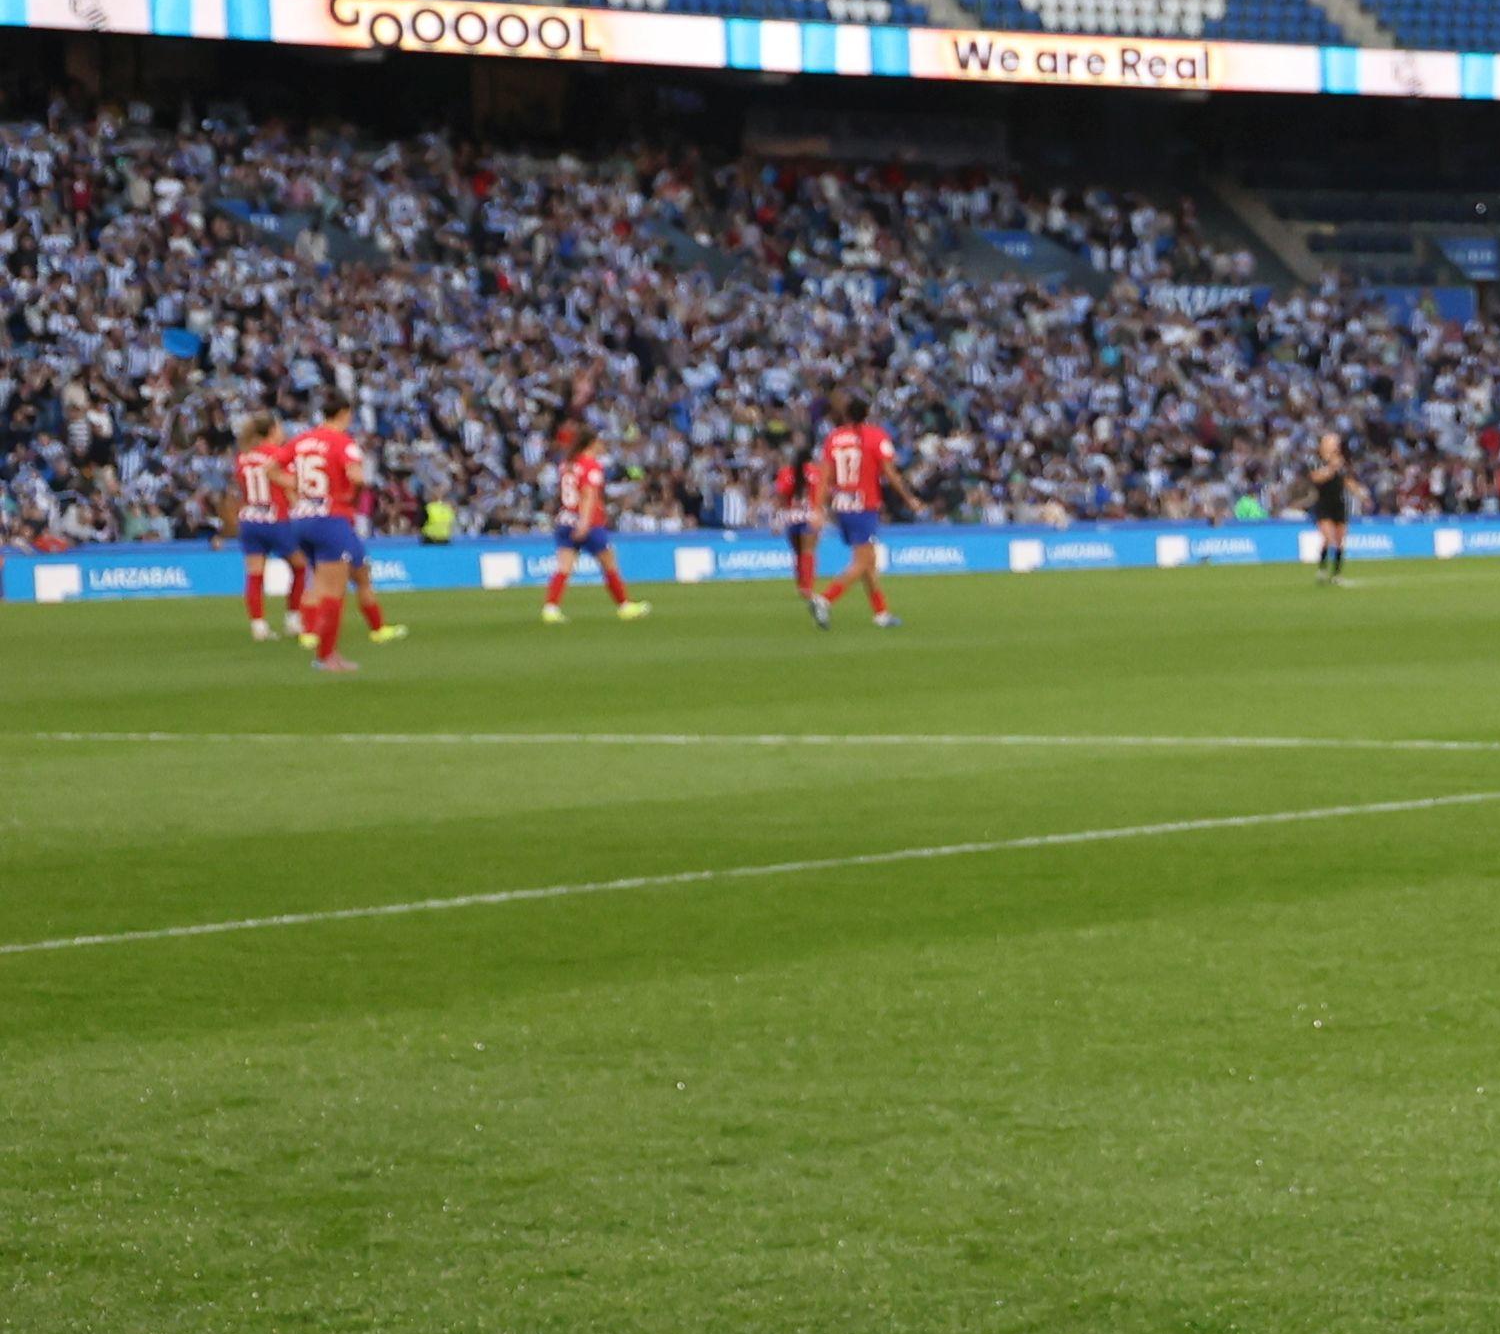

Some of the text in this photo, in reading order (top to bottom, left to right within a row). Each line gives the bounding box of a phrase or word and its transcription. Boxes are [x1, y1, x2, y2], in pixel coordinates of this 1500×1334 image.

[952, 40, 1212, 81] We are Real
